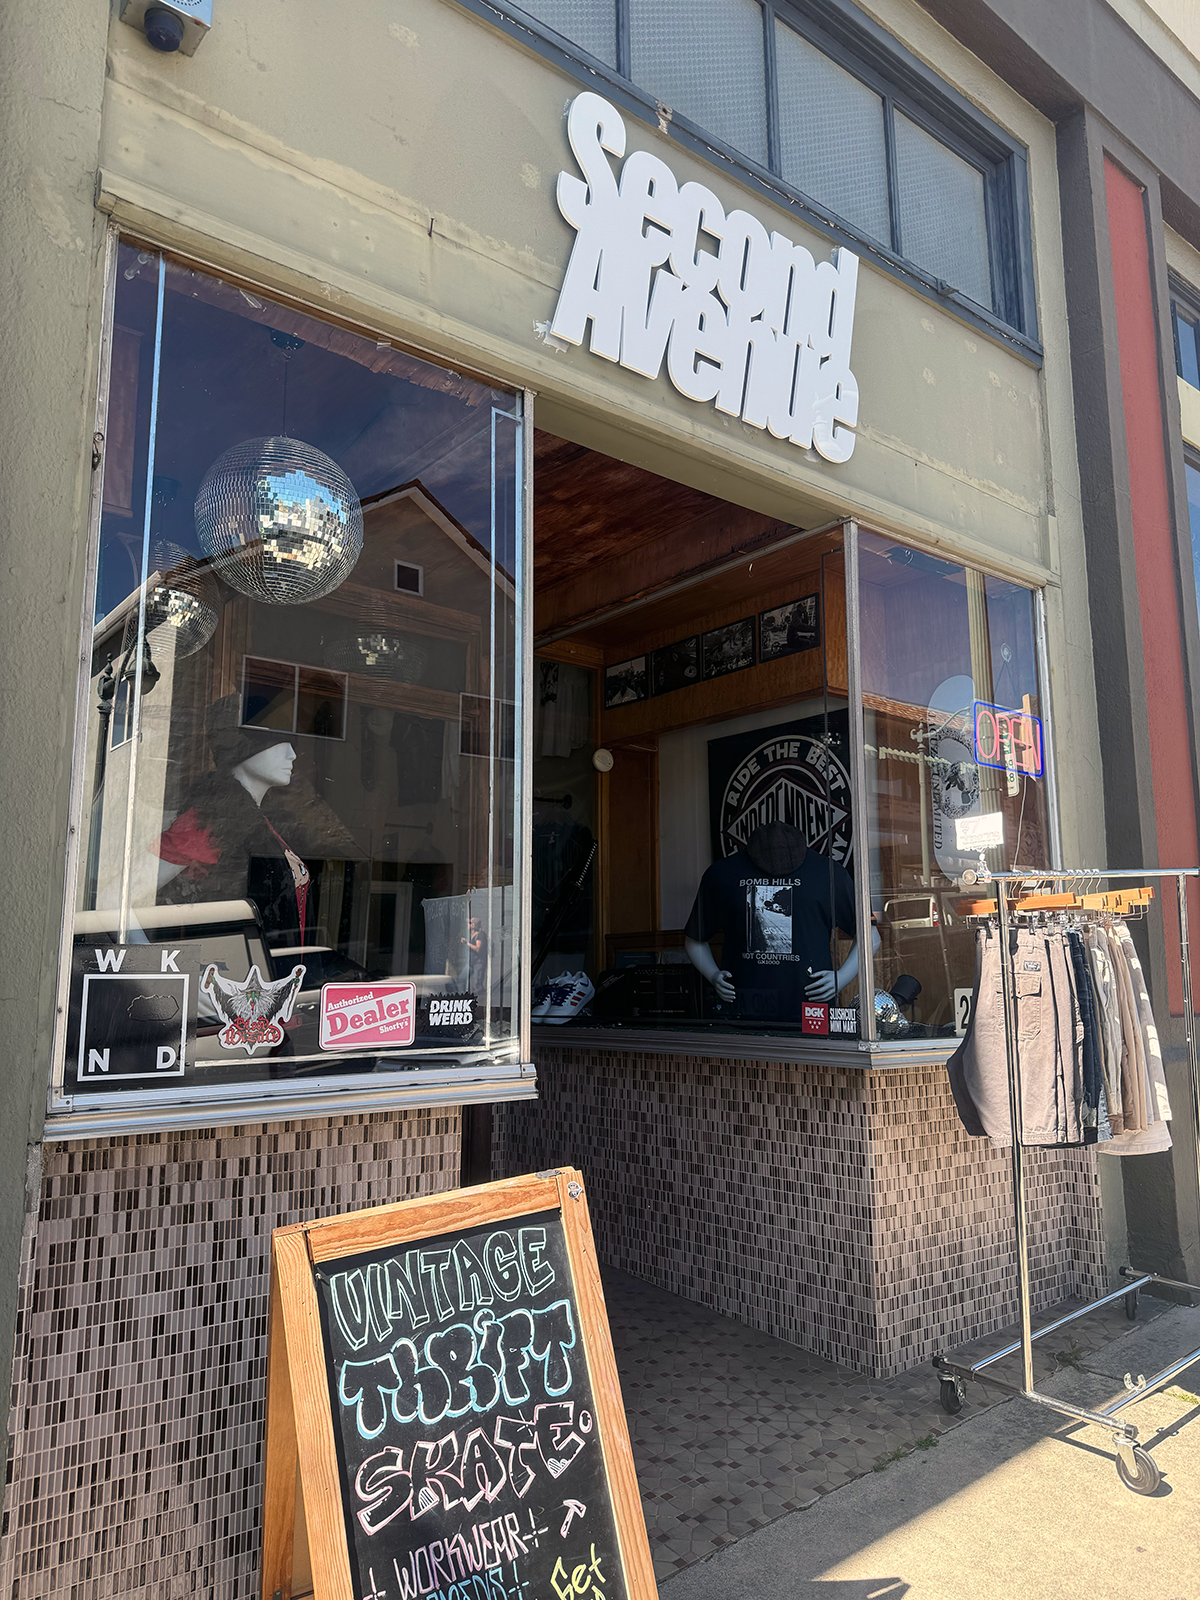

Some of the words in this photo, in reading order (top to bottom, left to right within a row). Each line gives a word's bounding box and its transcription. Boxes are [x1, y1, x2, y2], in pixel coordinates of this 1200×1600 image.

[557, 92, 859, 365] Second
[550, 228, 859, 463] Avenue
[976, 710, 1042, 770] OPEN
[727, 757, 761, 806] RIDE
[763, 741, 800, 762] THE
[805, 746, 846, 791] BEST
[739, 878, 770, 887] BOMB
[772, 878, 801, 887] HILLS
[755, 953, 801, 962] COUNTRIES
[327, 991, 374, 1011] Authorized
[429, 999, 473, 1013] DRINK
[326, 998, 409, 1037] Dealer
[429, 1012, 473, 1026] WEIRD
[805, 1007, 824, 1018] DGK
[232, 1015, 270, 1031] Blood
[379, 1018, 408, 1034] Shorty's
[330, 1228, 555, 1350] VINTAGE
[393, 1513, 529, 1600] WORKWEAR
